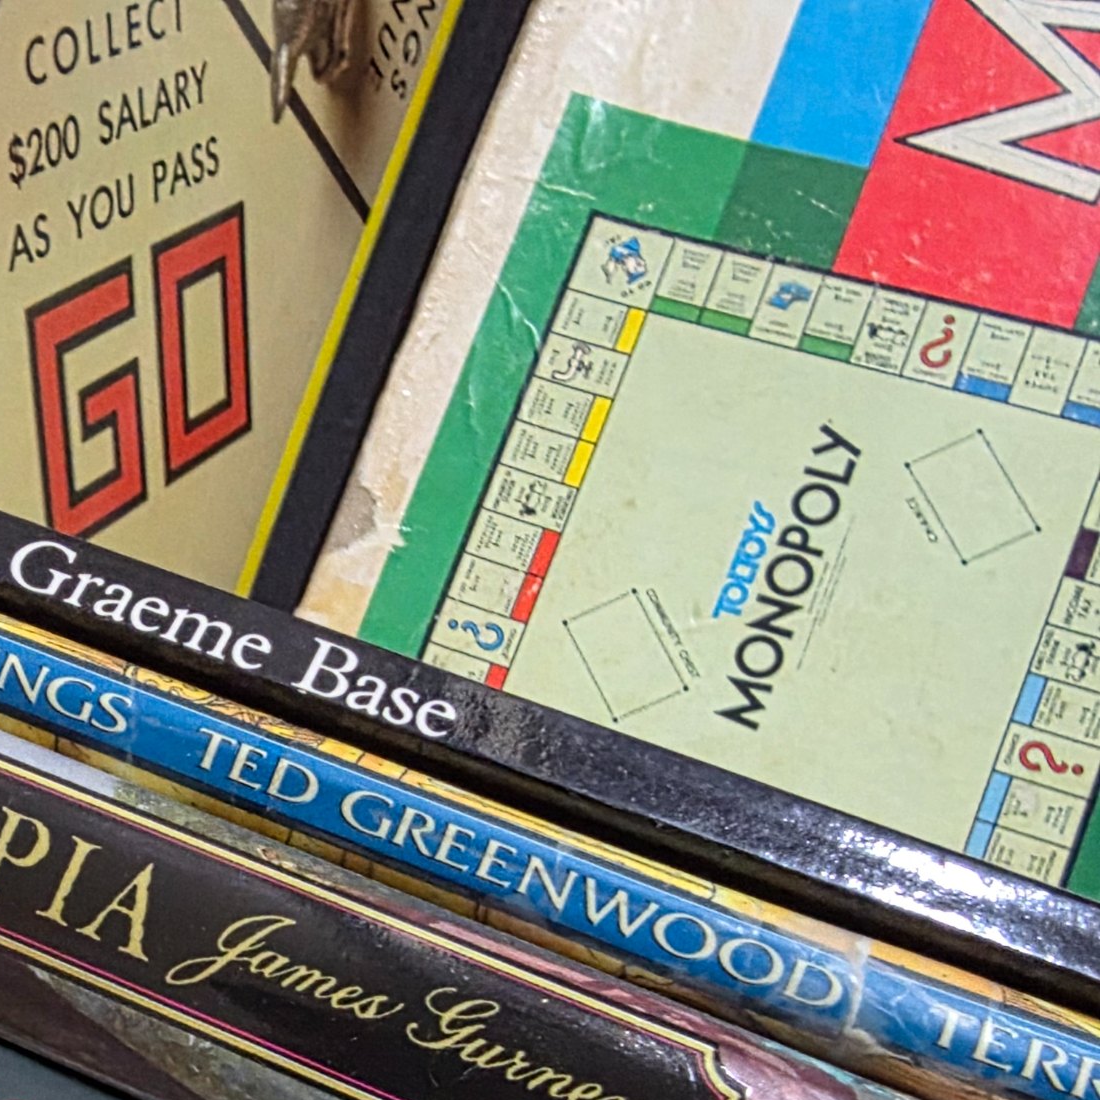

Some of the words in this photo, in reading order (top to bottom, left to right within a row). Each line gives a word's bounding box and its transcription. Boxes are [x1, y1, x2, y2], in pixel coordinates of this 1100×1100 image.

[25, 0, 185, 86] COLLECT
[8, 115, 80, 189] $200
[98, 62, 209, 145] SALARY
[8, 214, 51, 272] AS
[67, 173, 134, 239] YOU
[152, 136, 220, 203] PASS
[24, 200, 253, 540] GO
[711, 500, 776, 619] TOLTOYS
[712, 423, 862, 732] MONOPOLY
[9, 539, 273, 672] Graeme
[301, 641, 457, 740] Base
[196, 727, 322, 805] TED
[340, 790, 845, 1010] GREENWOOD
[165, 914, 408, 1027] James
